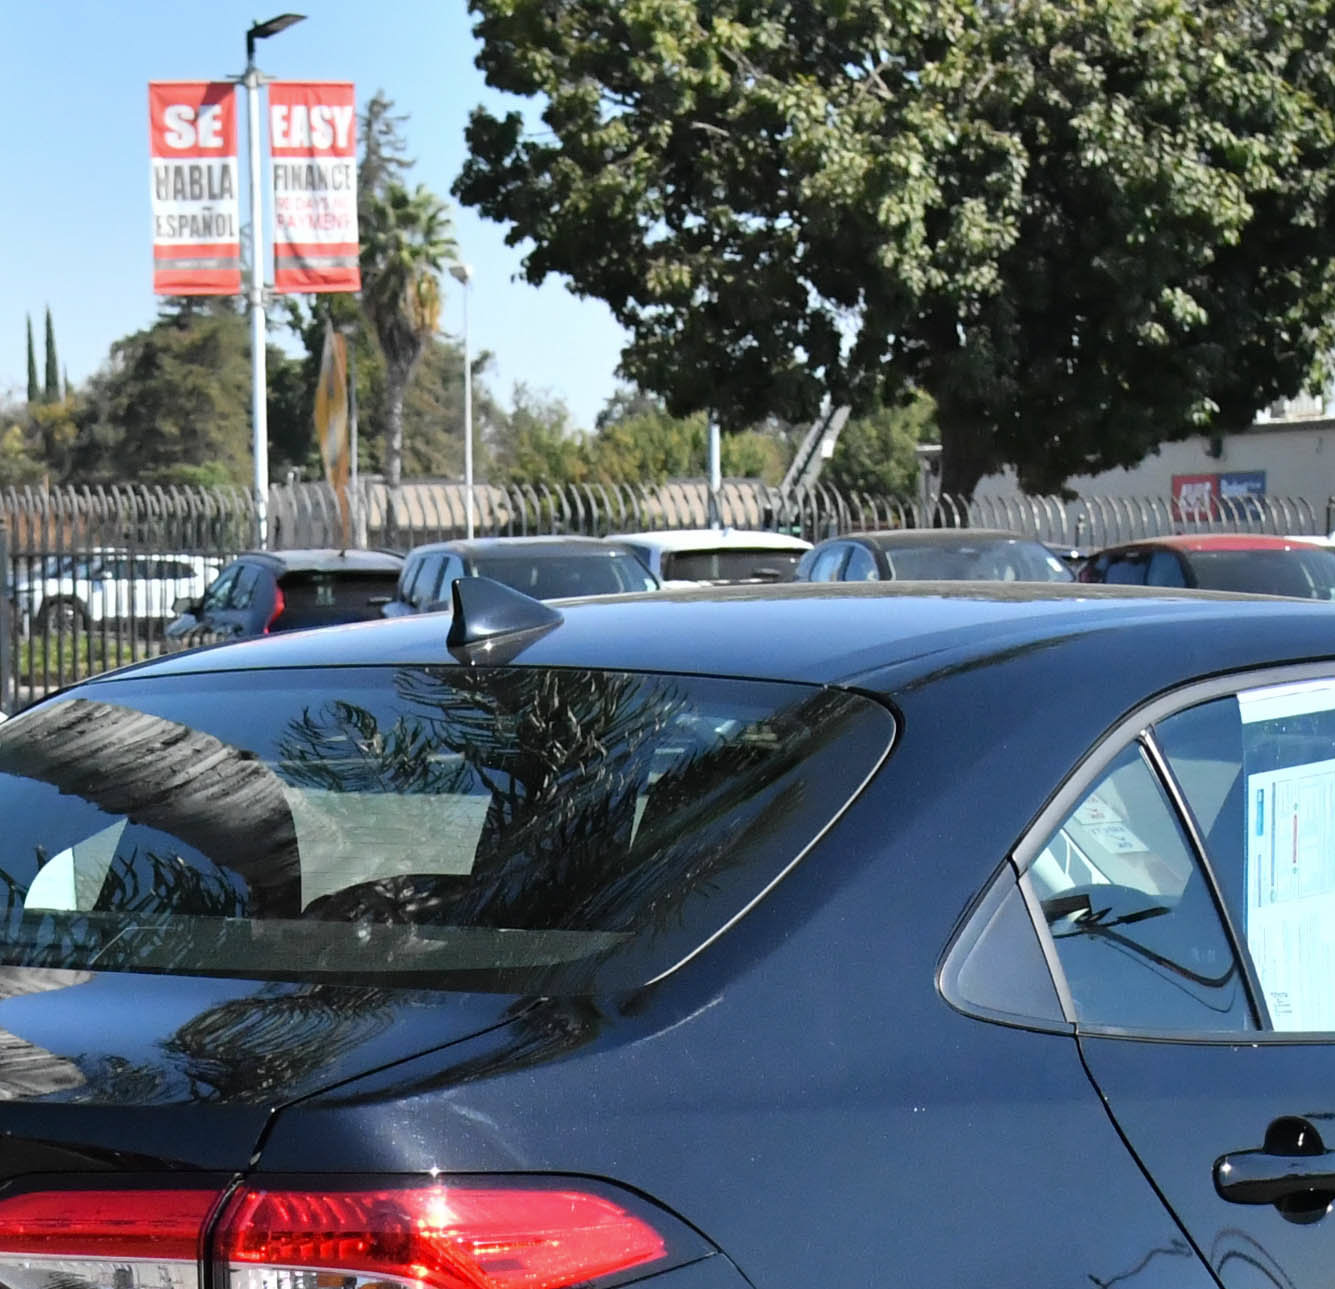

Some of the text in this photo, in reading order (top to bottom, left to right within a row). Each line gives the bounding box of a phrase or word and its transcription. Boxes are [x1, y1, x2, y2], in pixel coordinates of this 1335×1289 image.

[164, 104, 224, 149] SE
[271, 104, 353, 149] EASY
[155, 163, 234, 200] HABLA
[273, 163, 351, 191] FINANCE
[155, 206, 235, 239] ESPAÑOL
